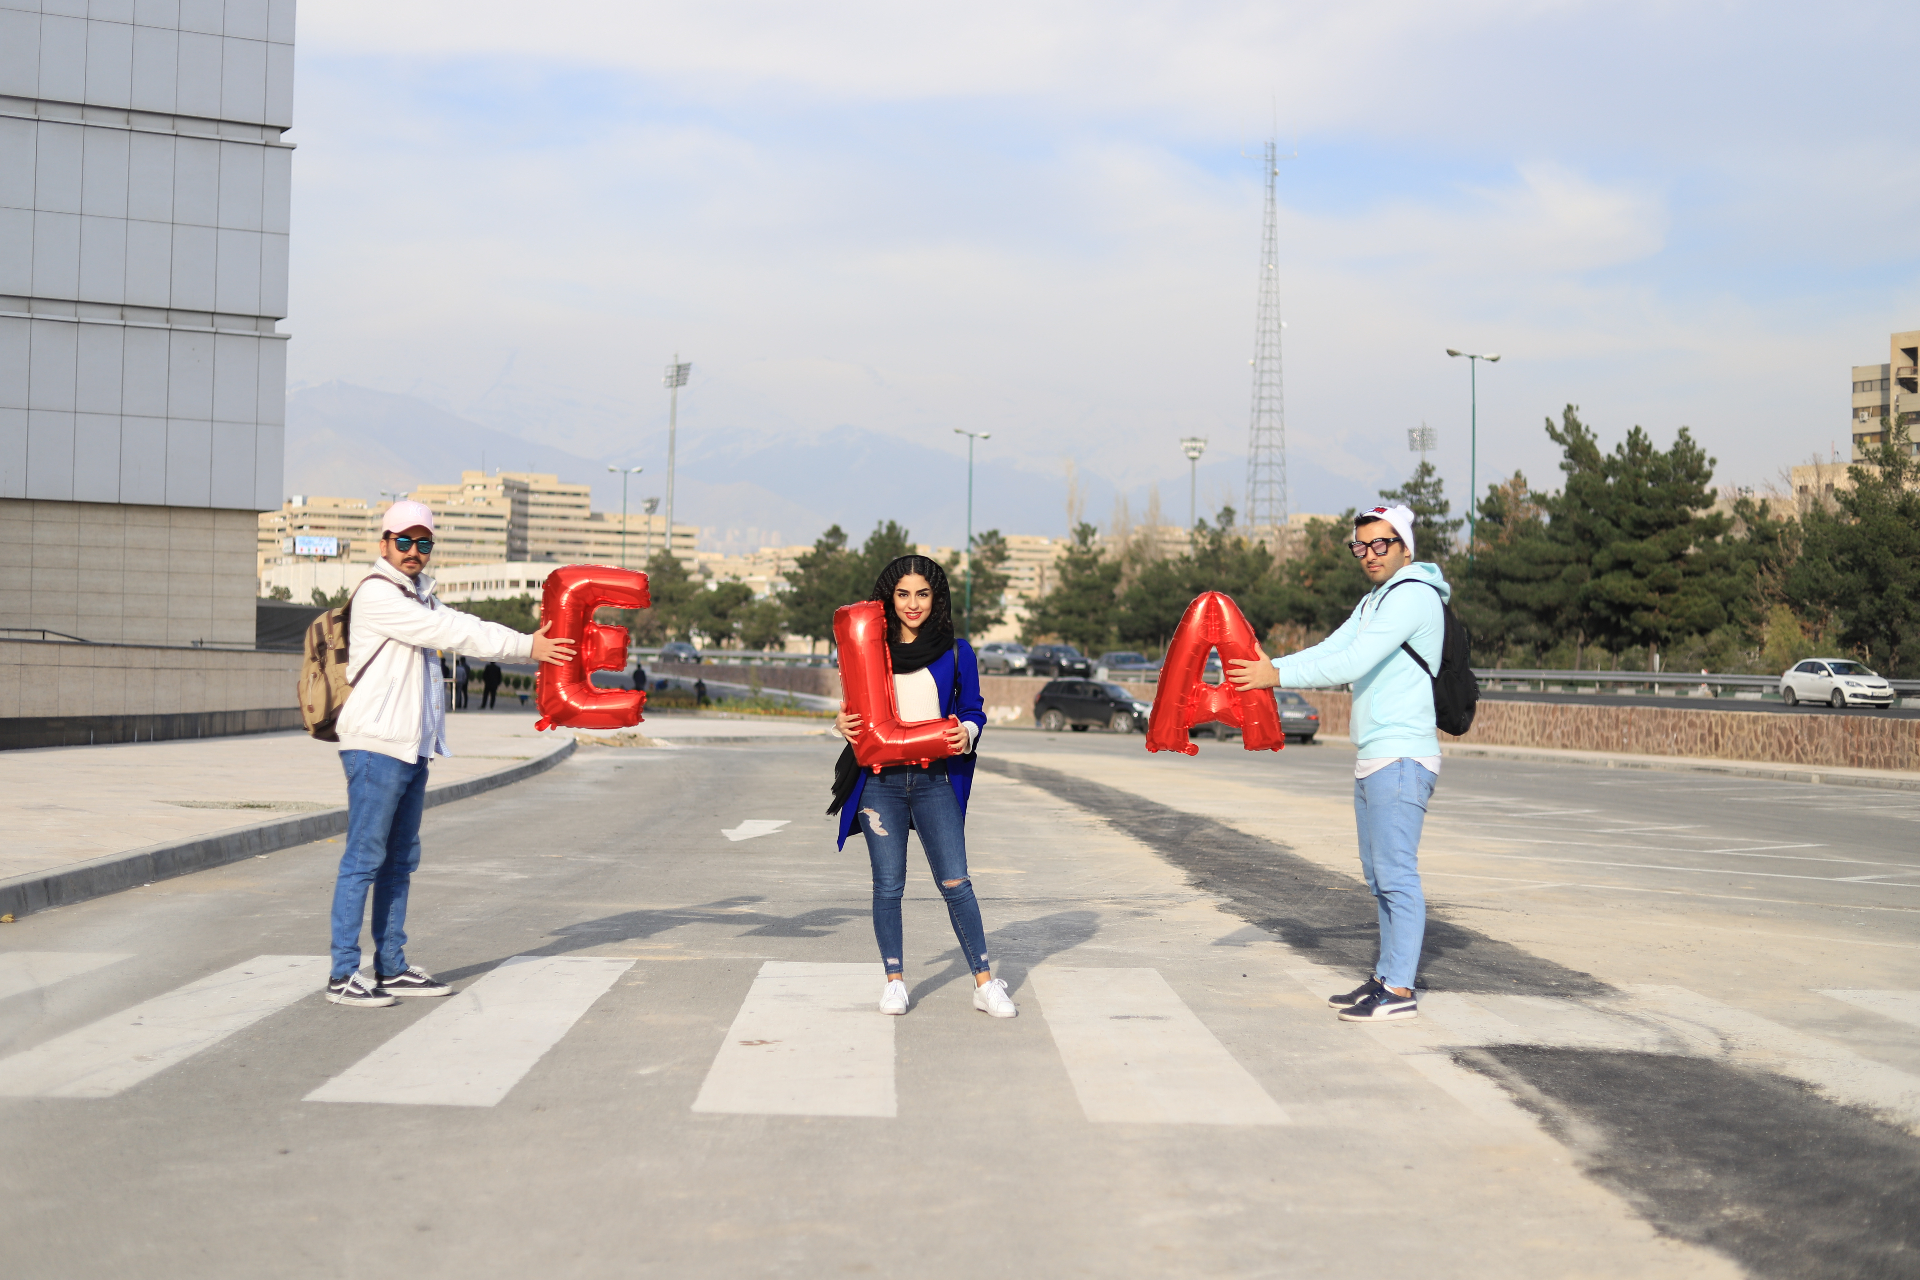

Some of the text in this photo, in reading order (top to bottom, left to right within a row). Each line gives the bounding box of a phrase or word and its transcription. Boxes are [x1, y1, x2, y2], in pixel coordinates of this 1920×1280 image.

[535, 564, 650, 731] E
[833, 600, 963, 771] L
[1146, 590, 1285, 755] A
